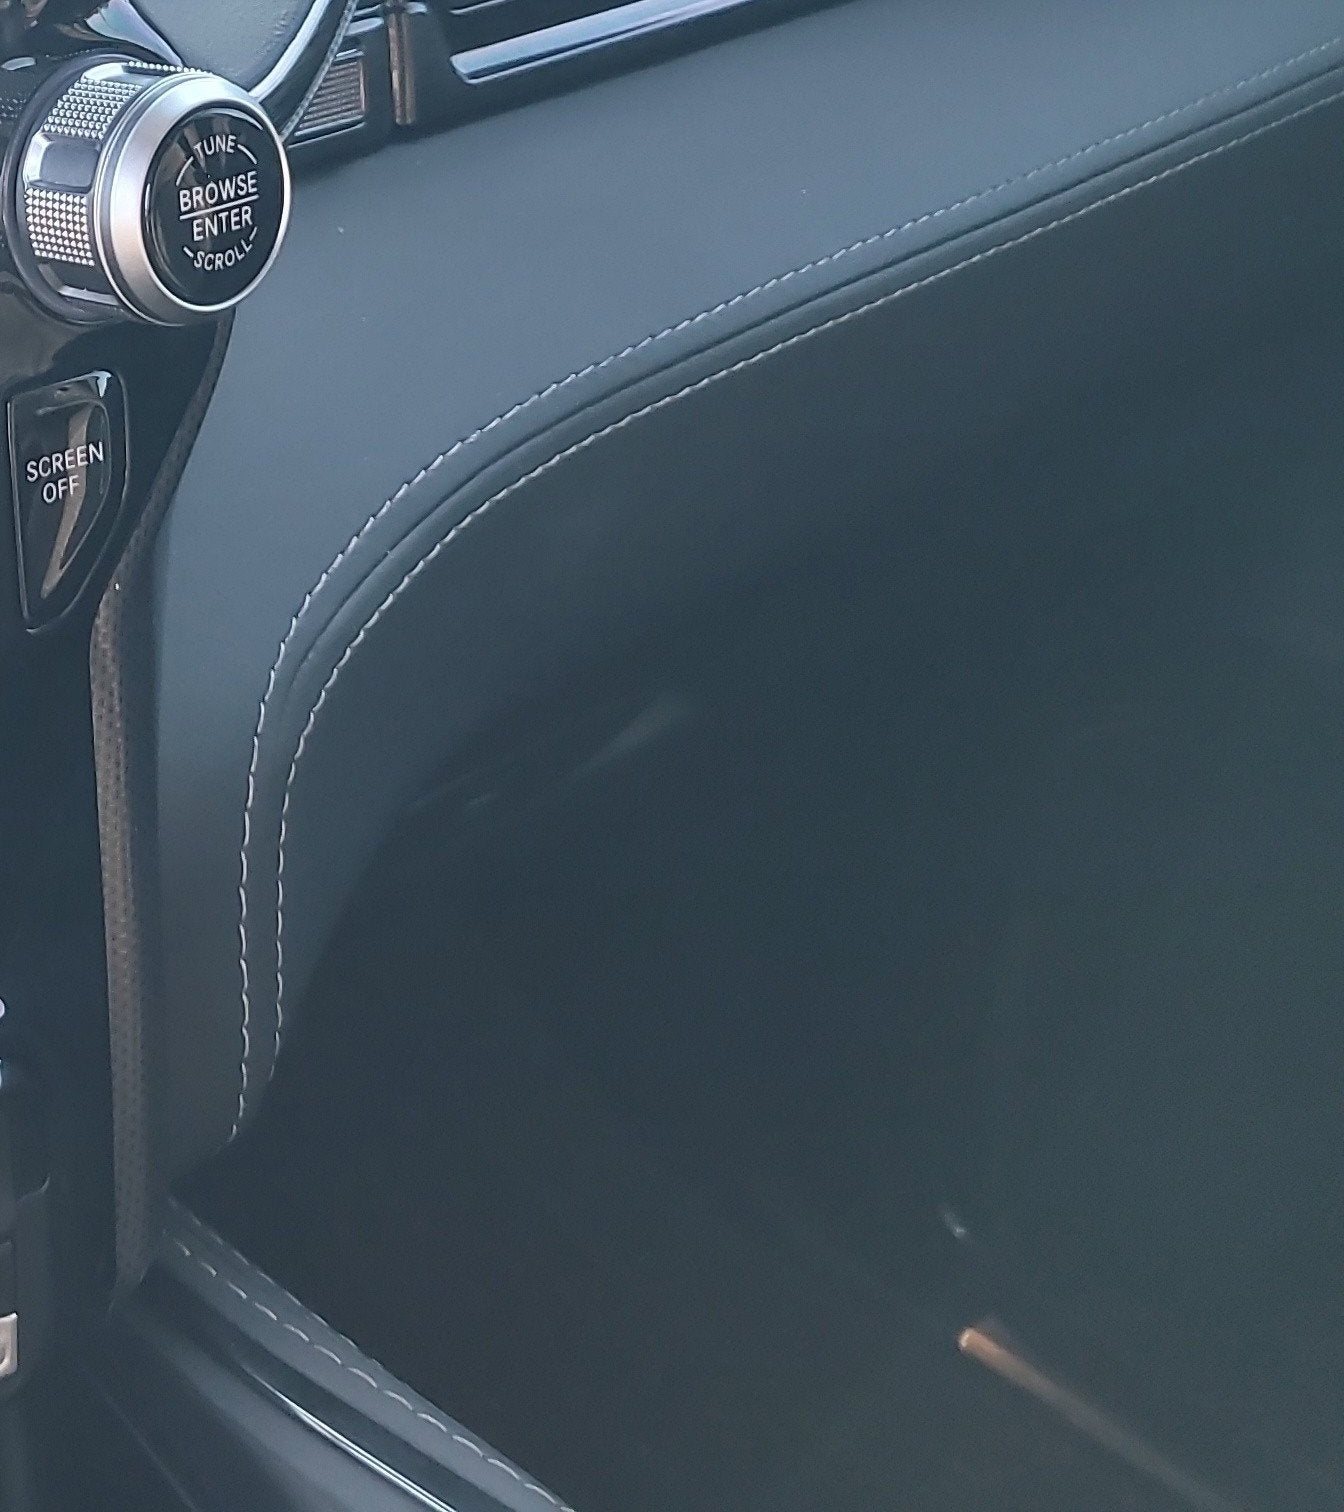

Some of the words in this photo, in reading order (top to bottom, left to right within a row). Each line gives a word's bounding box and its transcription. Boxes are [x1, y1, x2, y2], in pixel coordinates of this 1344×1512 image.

[193, 133, 237, 158] TUNE
[178, 169, 258, 214] BROWSE
[192, 205, 253, 242] ENTER
[193, 239, 254, 272] SCROLL
[25, 440, 105, 484] SCREEN
[41, 474, 80, 504] OFF
